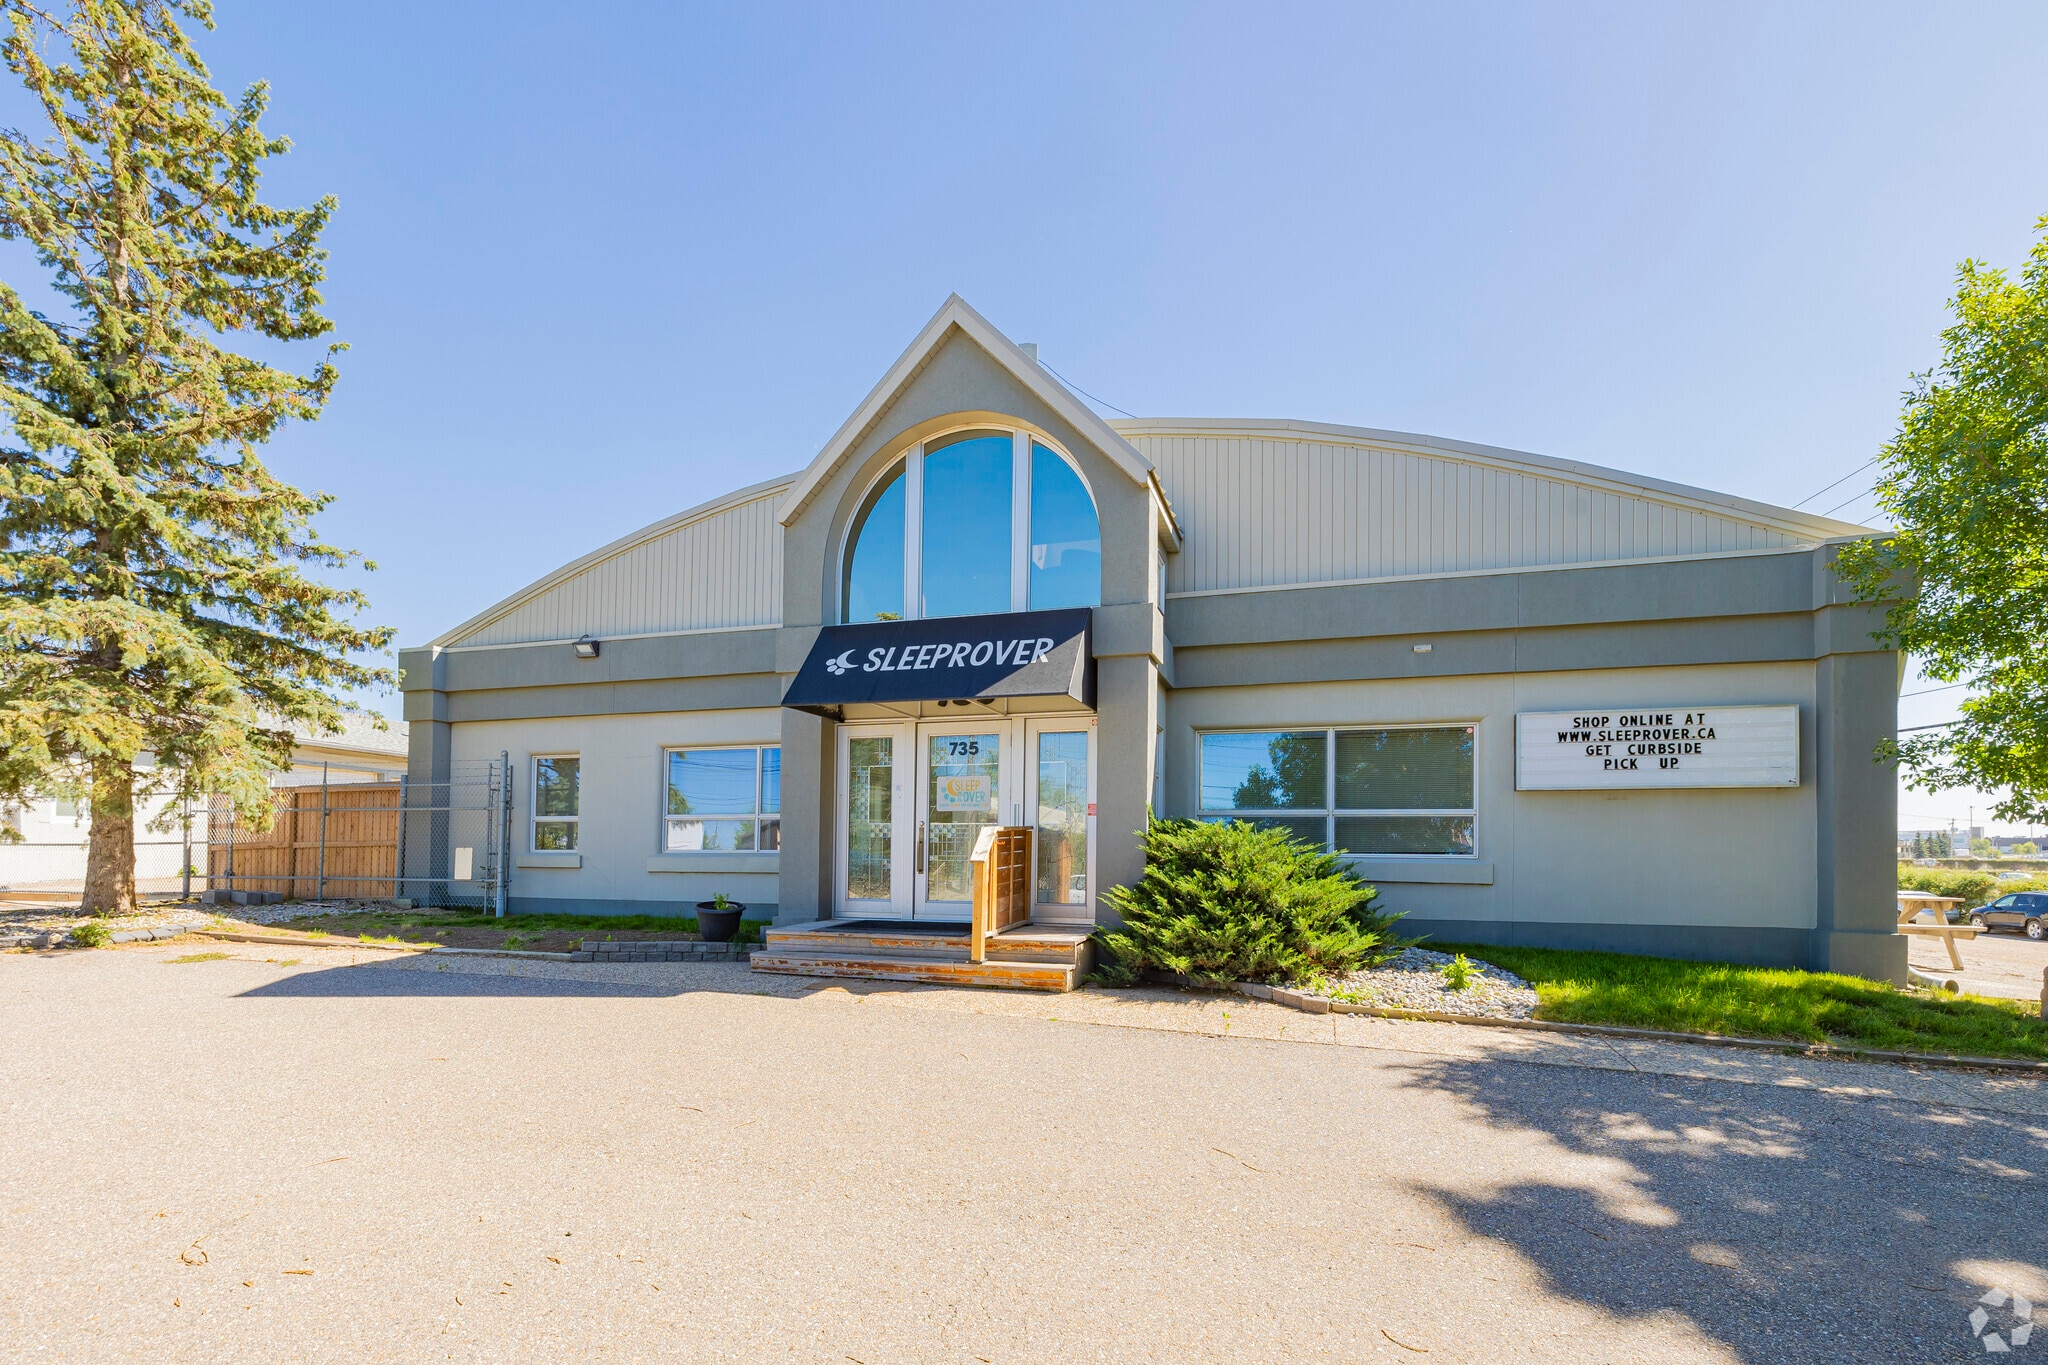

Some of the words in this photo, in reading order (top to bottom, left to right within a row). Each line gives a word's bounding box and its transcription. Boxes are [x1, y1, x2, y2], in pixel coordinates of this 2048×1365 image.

[862, 637, 1054, 672] SLEEPROVER
[1573, 716, 1610, 728] SHOP
[1619, 714, 1673, 727] ONLINE
[1684, 713, 1706, 726] AT
[1557, 727, 1716, 743] WWW.SLEEPROVER.CA
[949, 741, 979, 756] 735
[1585, 744, 1611, 756] GET
[1627, 742, 1702, 755] CURBSIDE
[1603, 758, 1638, 770] PICK
[1659, 757, 1680, 769] UP
[955, 779, 981, 791] SLEEP
[957, 791, 986, 803] ROVER
